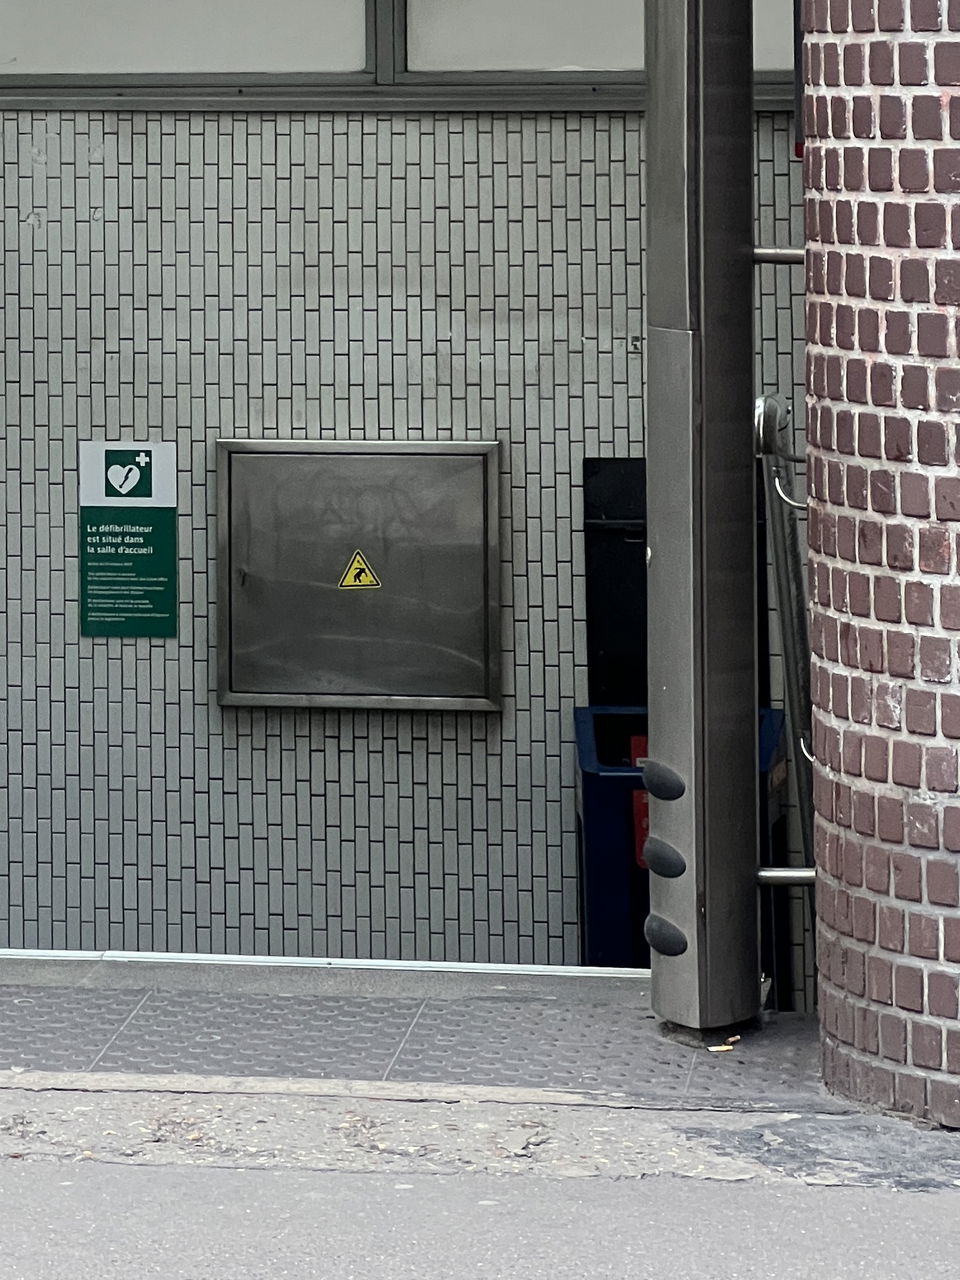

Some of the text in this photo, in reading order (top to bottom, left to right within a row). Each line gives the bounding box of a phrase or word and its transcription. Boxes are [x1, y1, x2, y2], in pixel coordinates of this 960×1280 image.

[87, 524, 153, 533] Le défibrillateur
[87, 534, 144, 544] est situé dans
[87, 545, 95, 554] la
[96, 545, 116, 554] salle
